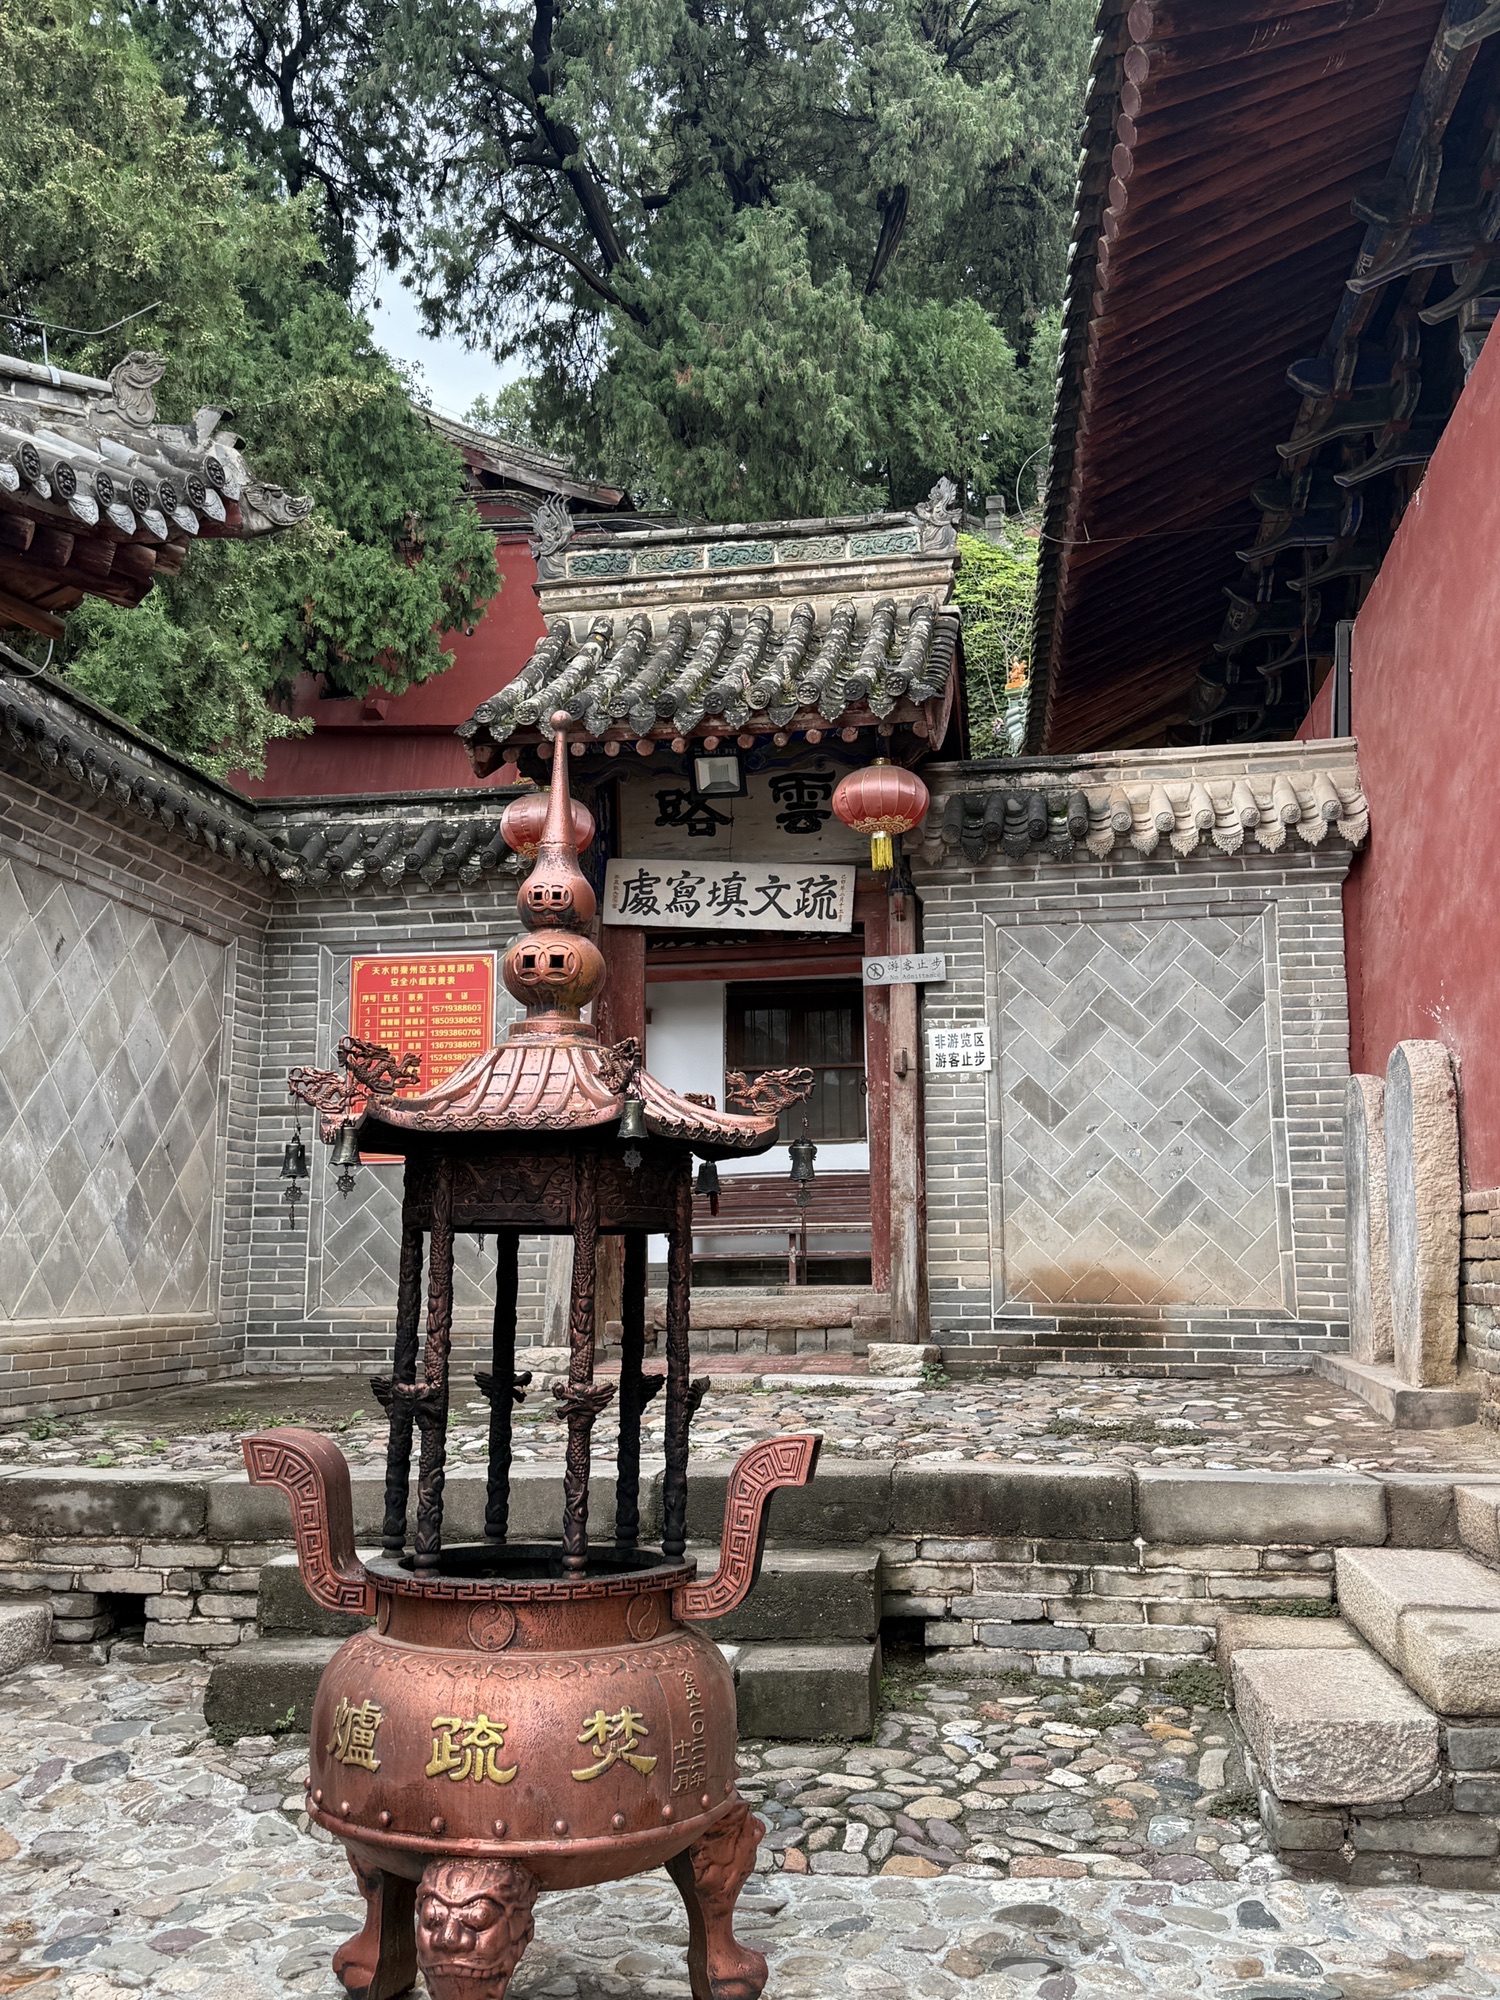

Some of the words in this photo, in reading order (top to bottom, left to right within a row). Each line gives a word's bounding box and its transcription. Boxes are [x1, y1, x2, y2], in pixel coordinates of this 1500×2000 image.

[887, 957, 943, 972] 游客止步
[390, 976, 456, 987] 安全小组职责表
[902, 972, 941, 980] Admittance
[364, 1019, 371, 1027] 2
[364, 1031, 370, 1039] 3
[934, 1032, 985, 1049] 非游览区
[935, 1050, 986, 1068] 游客止步
[672, 1739, 691, 1792] 十二月
